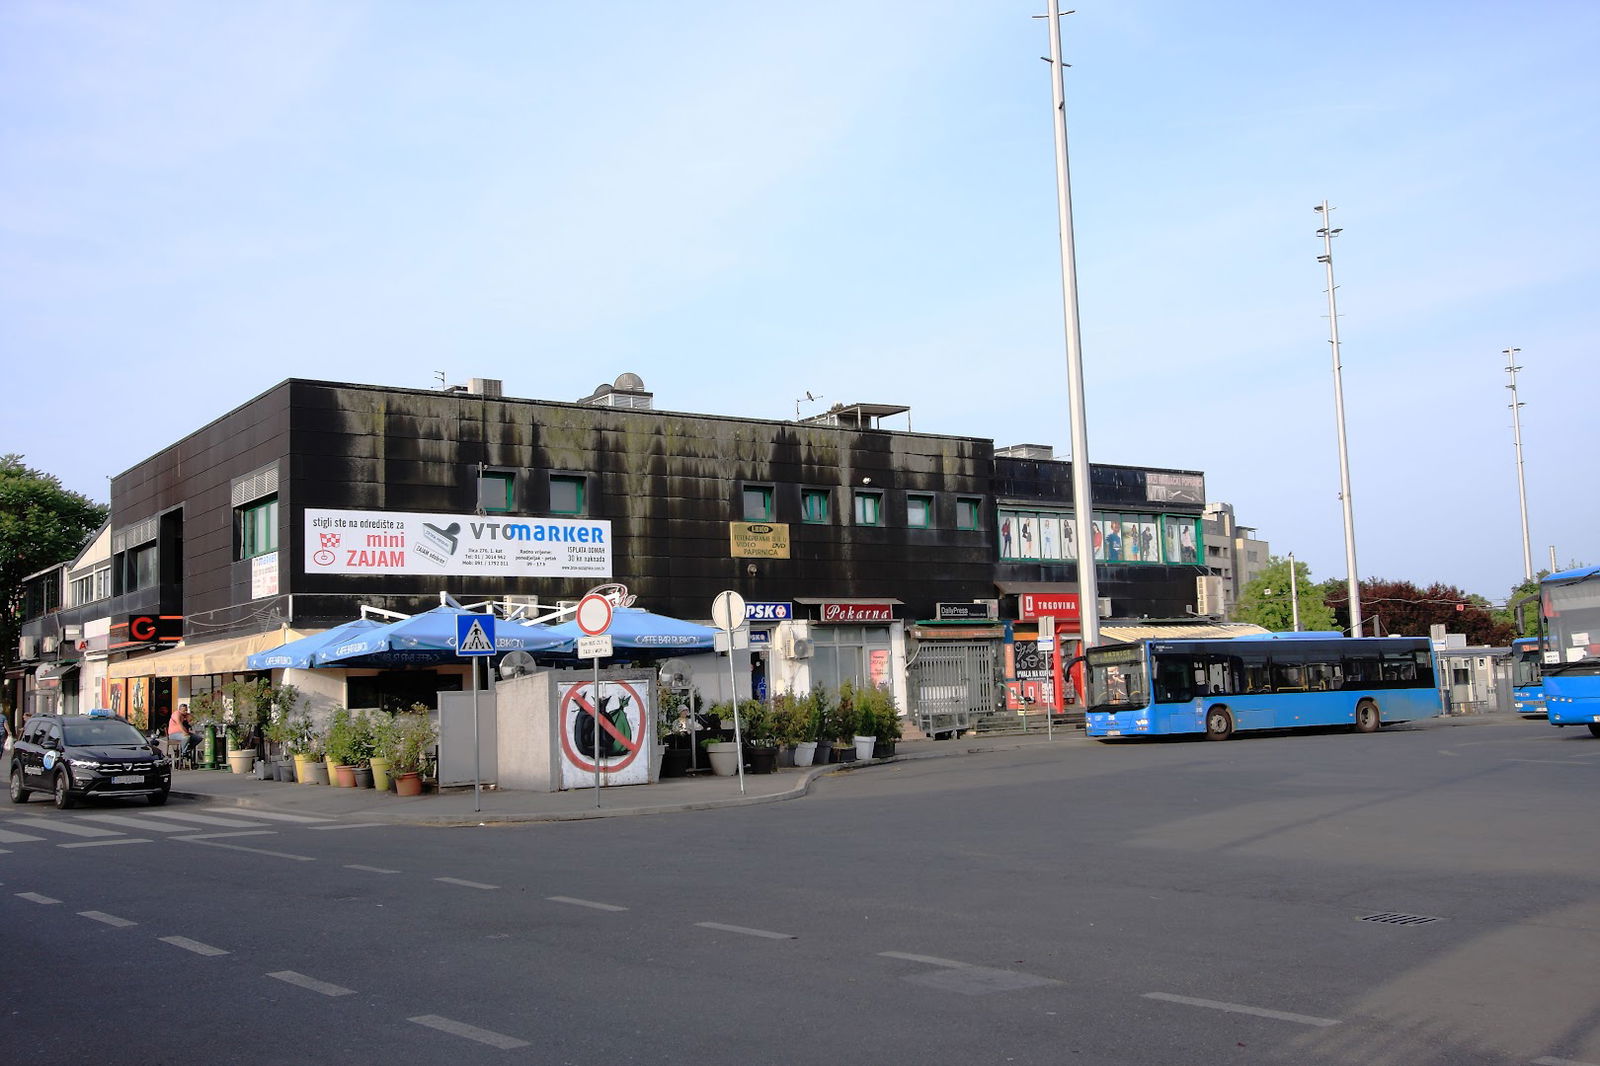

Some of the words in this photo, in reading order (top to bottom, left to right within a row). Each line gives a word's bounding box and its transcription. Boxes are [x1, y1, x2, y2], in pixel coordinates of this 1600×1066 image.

[313, 517, 333, 529] stigli
[334, 519, 347, 528] ste
[348, 520, 358, 528] na
[360, 519, 394, 529] odredište
[396, 521, 405, 529] za
[366, 531, 405, 548] mini
[346, 550, 405, 567] ZAJAM
[826, 604, 889, 620] Pekarna
[940, 606, 969, 615] DailyPress
[1037, 601, 1076, 610] TRGOVINA
